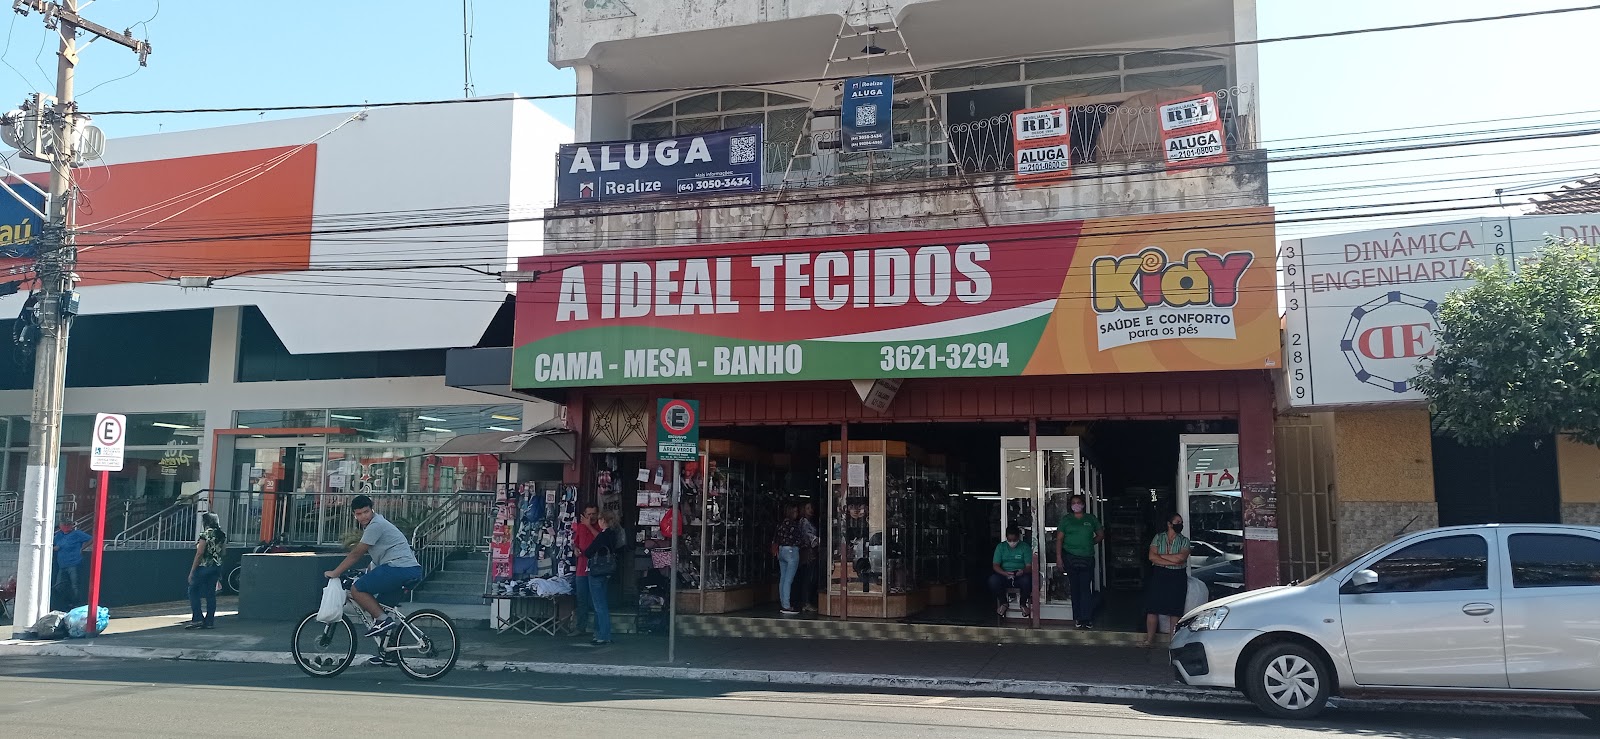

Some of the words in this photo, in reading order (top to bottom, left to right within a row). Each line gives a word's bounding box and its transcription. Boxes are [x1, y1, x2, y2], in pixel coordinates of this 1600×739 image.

[851, 89, 883, 97] ALUGA
[1168, 104, 1209, 122] REI
[1022, 117, 1060, 132] REI
[1170, 133, 1218, 152] ALUGA
[568, 136, 713, 174] ALUGA
[1020, 148, 1065, 164] ALUGA
[606, 179, 662, 196] Realize
[678, 183, 694, 193] (64)
[696, 177, 751, 190] 3050-3434
[1344, 230, 1475, 263] DINÂMICA
[555, 265, 588, 322] A
[600, 256, 739, 320] IDEAL
[751, 243, 992, 312] TECIDOS
[1311, 257, 1474, 294] ENGENHARIA
[1099, 317, 1141, 335] SAÚDE
[1146, 316, 1154, 326] E
[1159, 313, 1231, 325] CONFORTO
[1128, 328, 1158, 340] para
[1162, 326, 1175, 336] os
[1178, 324, 1199, 336] pés
[534, 350, 604, 383] CAMA
[623, 347, 693, 379] MESA
[713, 343, 804, 376] BANHO
[879, 341, 1010, 372] 3621-3294
[672, 408, 685, 426] E
[104, 421, 114, 440] E
